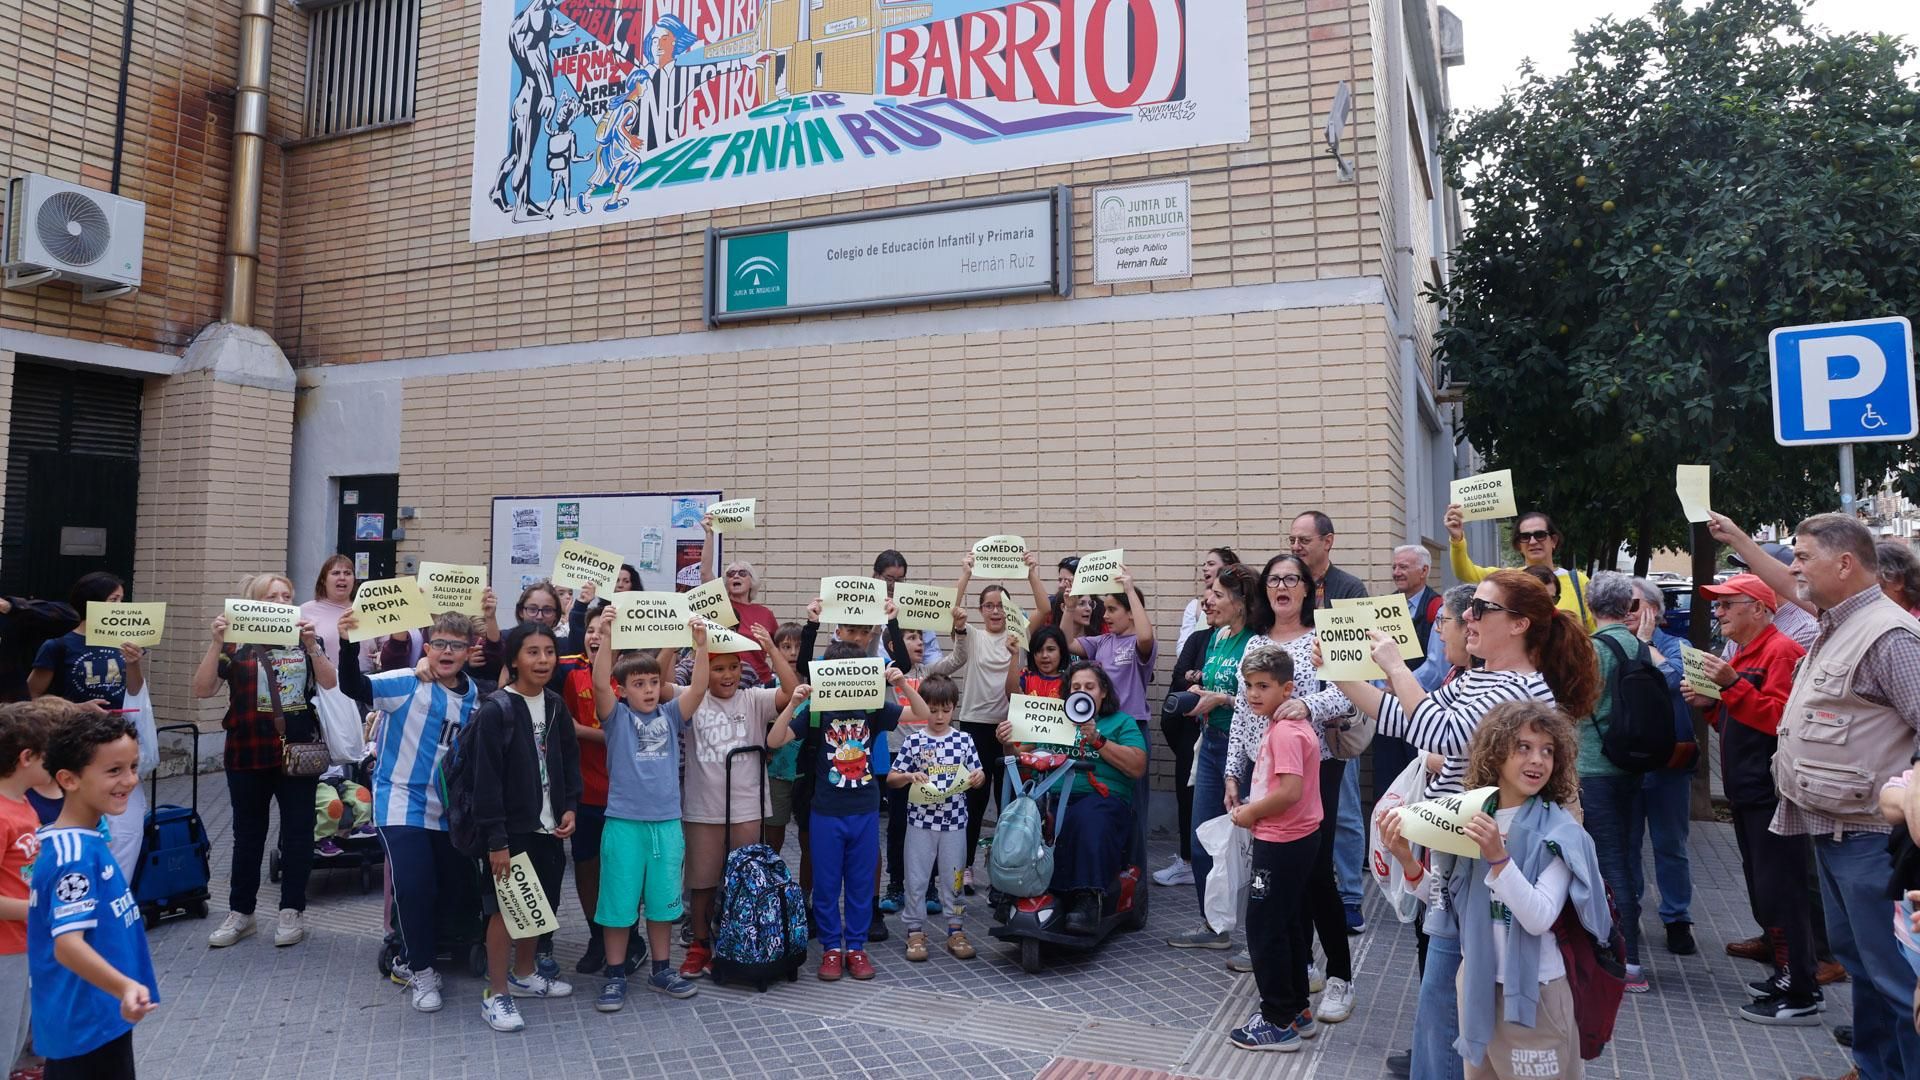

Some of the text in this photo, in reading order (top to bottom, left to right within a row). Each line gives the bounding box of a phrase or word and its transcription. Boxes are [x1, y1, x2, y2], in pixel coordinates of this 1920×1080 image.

[884, 0, 1160, 108] BARRIO
[1128, 197, 1177, 212] JUNTA DE
[827, 227, 1034, 261] Colegio de Educación Infantil y Primaria
[1115, 245, 1140, 256] Colegio
[961, 256, 1004, 273] Hernán
[1798, 335, 1887, 432] P
[1458, 480, 1502, 494] COMEDOR
[711, 506, 750, 515] COMEDOR
[717, 516, 743, 524] DIGNO
[976, 544, 1024, 553] COMEDOR
[563, 550, 615, 573] COMEDOR
[1078, 561, 1118, 574] COMEDOR
[429, 573, 480, 585] COMEDOR
[561, 563, 611, 583] CON PRODUCTOS
[1081, 574, 1109, 583] DIGNO
[834, 580, 876, 590] COCINA
[359, 584, 402, 599] COCINA
[697, 589, 707, 598] UN
[438, 600, 464, 608] CALIDAD
[688, 593, 723, 613] MEDOR
[836, 593, 876, 603] PROPIA
[899, 596, 951, 609] COMEDOR
[232, 604, 294, 614] COMEDOR
[361, 598, 409, 613] PROPIA
[626, 609, 677, 619] COCINA
[906, 609, 940, 620] DIGNO
[101, 617, 151, 626] COCINA
[1331, 616, 1354, 625] POR UN
[119, 629, 156, 637] COLEGIO
[247, 624, 293, 633] CALIDAD
[634, 624, 645, 632] MI
[647, 623, 684, 632] COLEGIO
[1320, 628, 1371, 642] COMEDOR
[1330, 649, 1363, 662] DIGNO
[817, 665, 880, 677] COMEDOR
[818, 688, 879, 699] DE CALIDAD
[1024, 700, 1065, 712] COCINA
[697, 708, 729, 727] SEA
[1025, 713, 1064, 725] PROPIA
[928, 765, 947, 775] PAW
[1412, 805, 1421, 814] MI
[511, 864, 546, 928] COMEDOR
[497, 889, 525, 930] CALIDAD
[507, 890, 530, 926] PRODUCTOS
[1511, 1048, 1558, 1063] SUPER
[1511, 1061, 1560, 1077] MARIO
